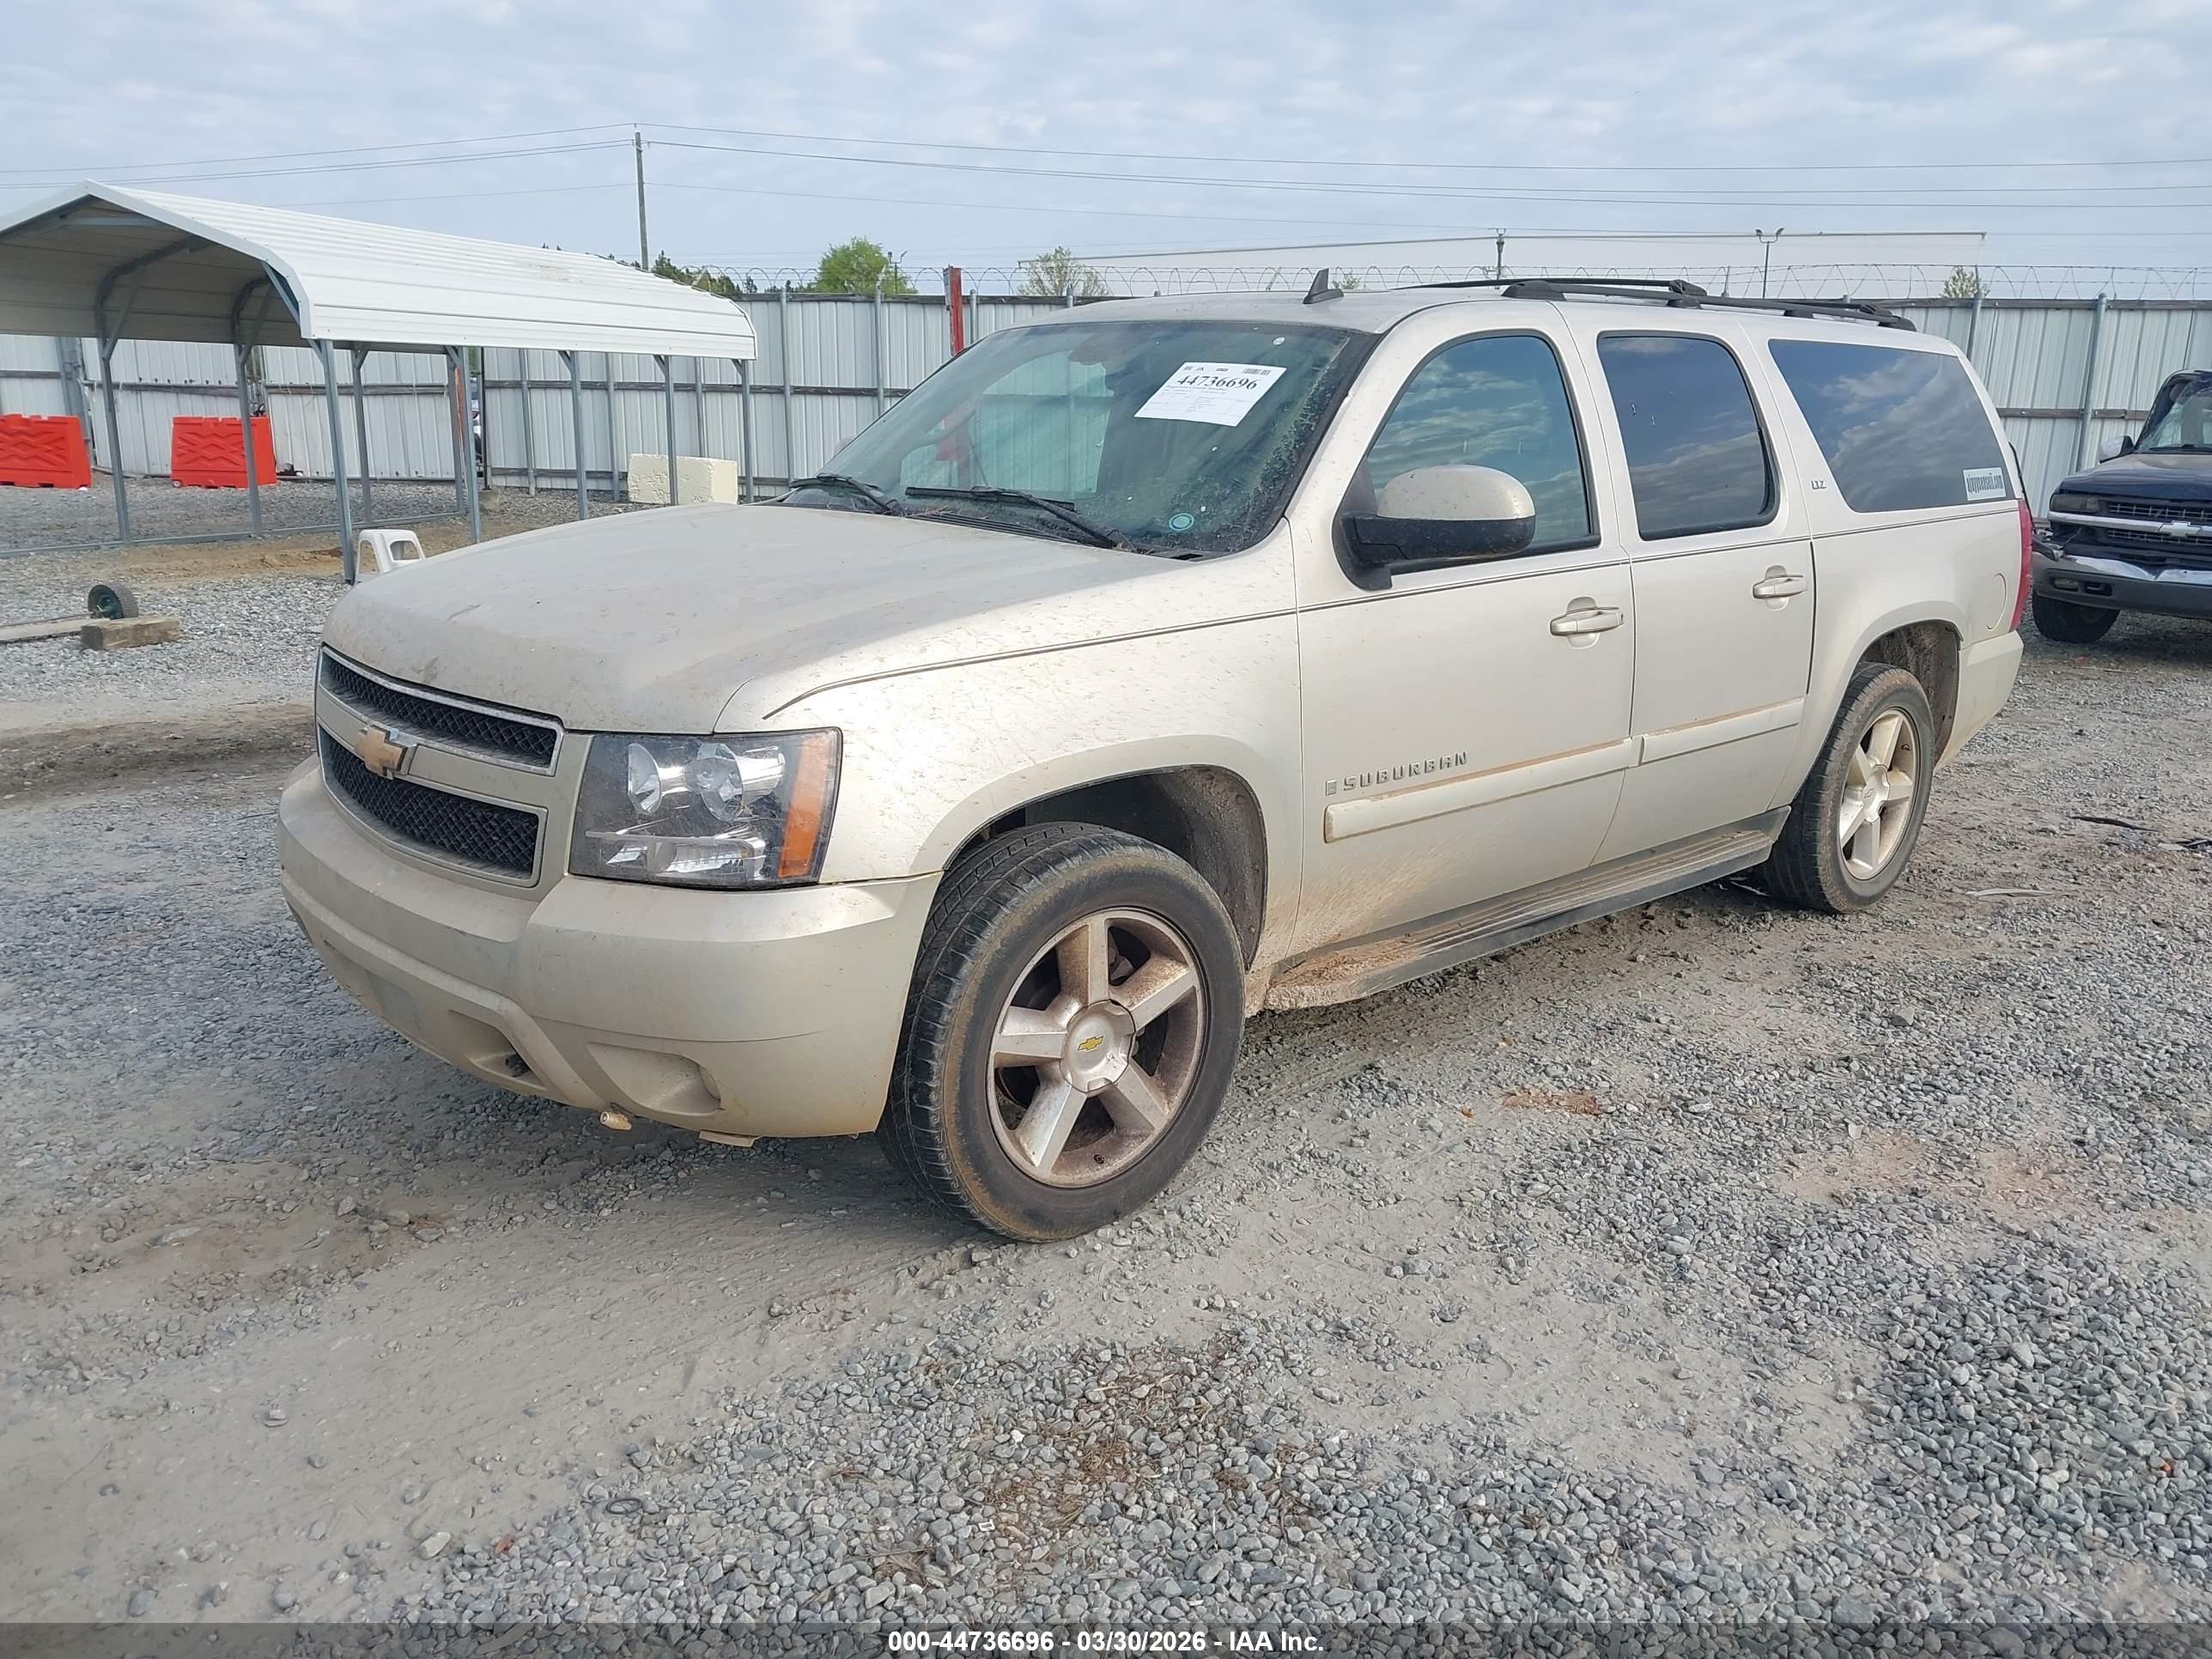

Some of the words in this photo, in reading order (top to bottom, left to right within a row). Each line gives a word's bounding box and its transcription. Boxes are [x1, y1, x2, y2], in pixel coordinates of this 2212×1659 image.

[1176, 374, 1261, 390] 44736696
[1810, 480, 1827, 490] LTZ
[1343, 750, 1468, 791] SUBURBAN
